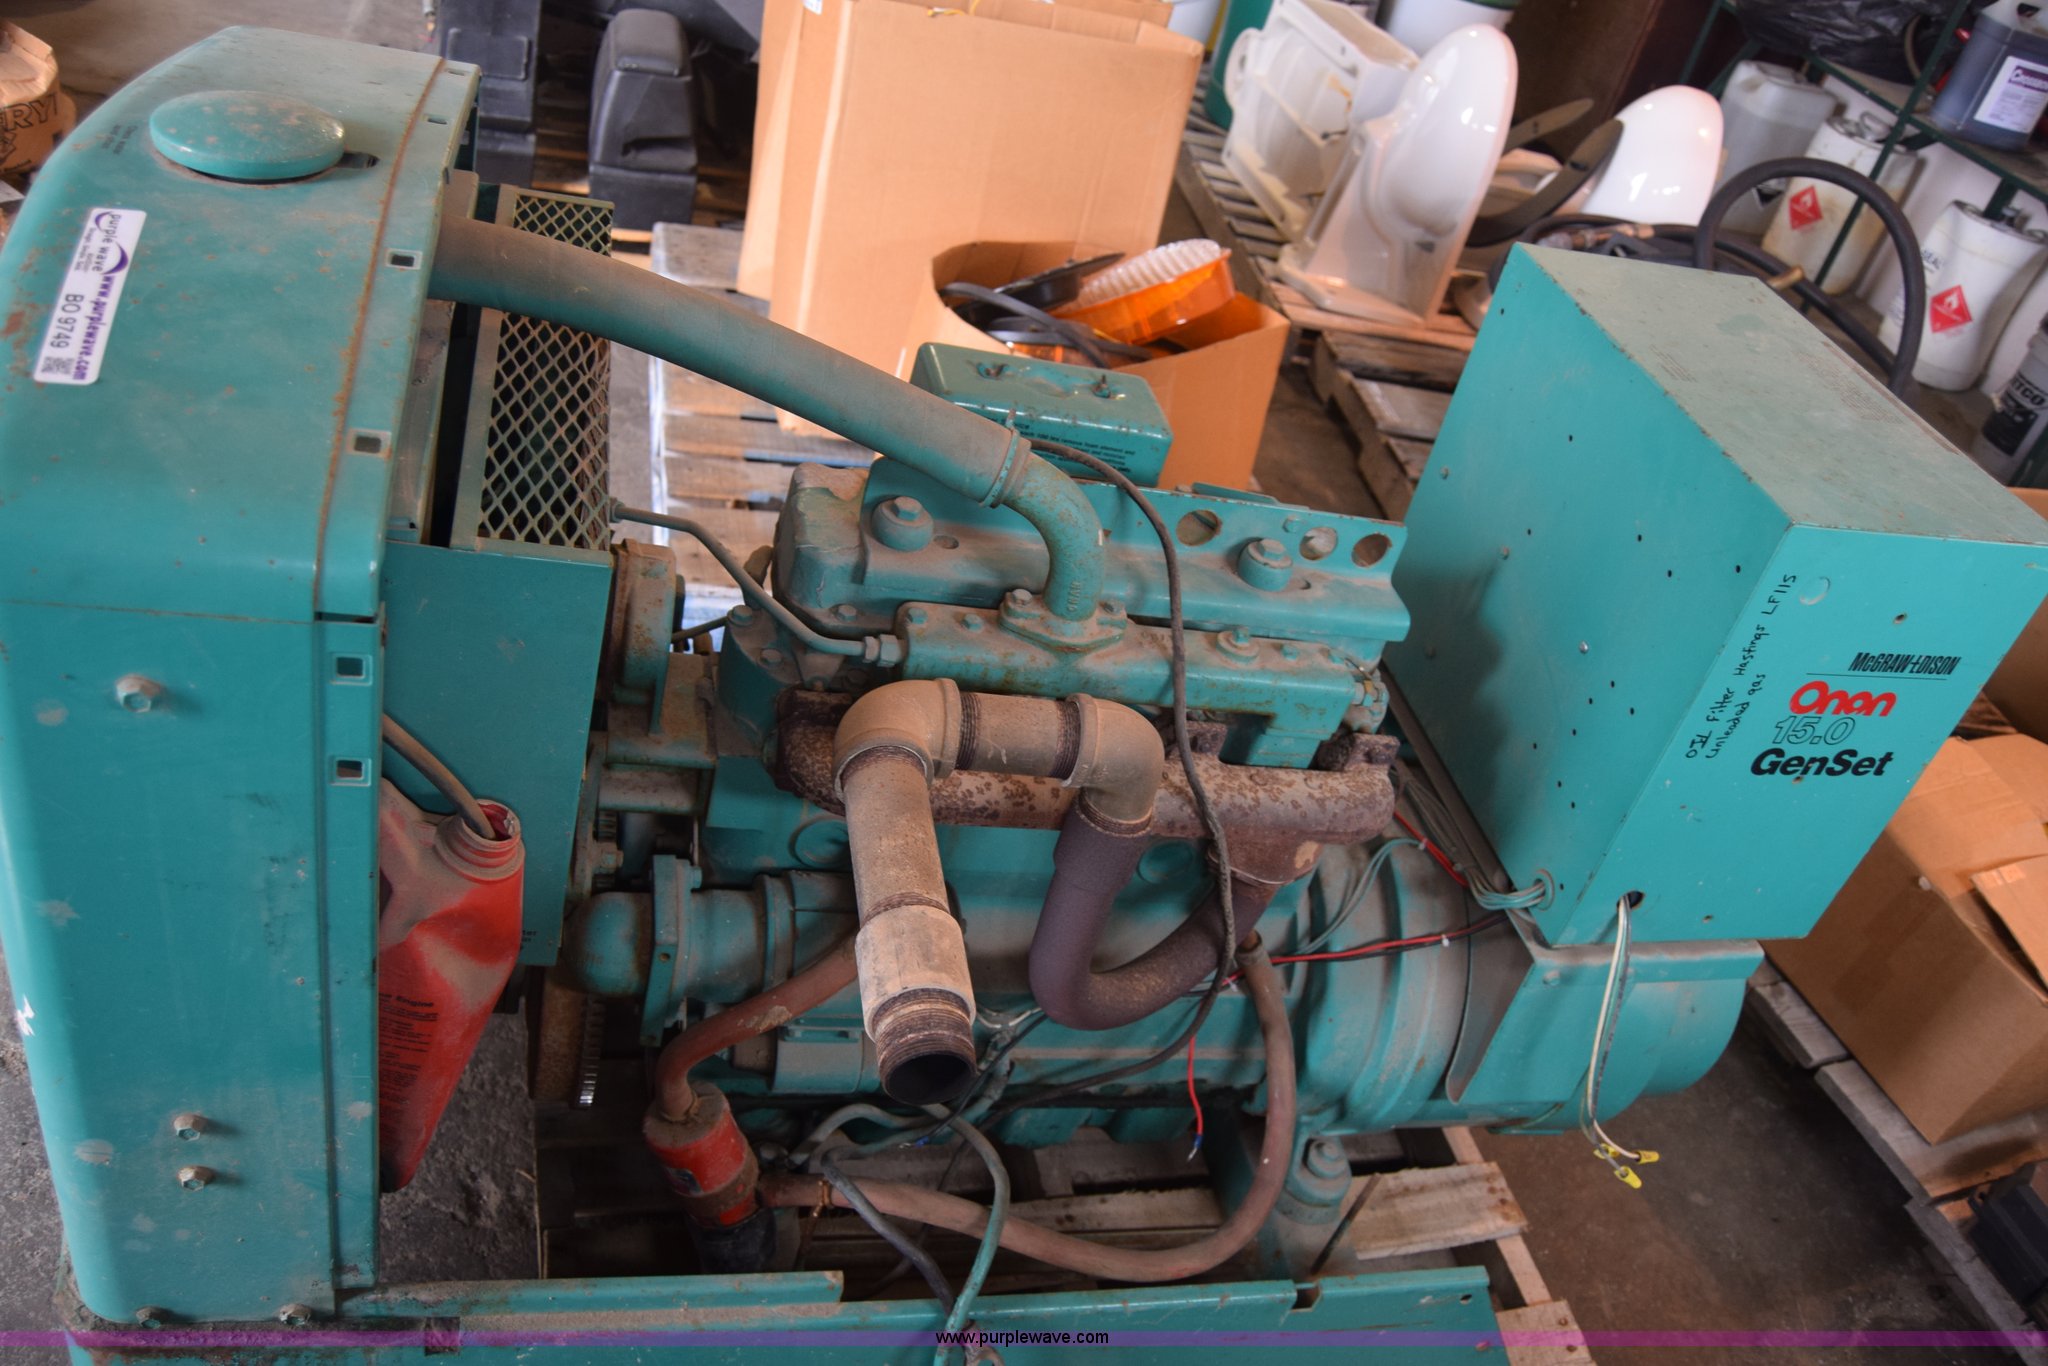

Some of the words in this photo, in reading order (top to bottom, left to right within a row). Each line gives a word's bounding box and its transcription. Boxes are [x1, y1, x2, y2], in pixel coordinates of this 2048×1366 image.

[102, 214, 121, 243] purple
[92, 246, 108, 272] wave
[50, 317, 77, 349] 9749
[72, 275, 116, 380] www.purplewave.com
[1733, 624, 1770, 676] Hastings
[1789, 680, 1897, 717] Onan
[1772, 715, 1856, 745] 15.0
[1751, 748, 1894, 776] GenSet
